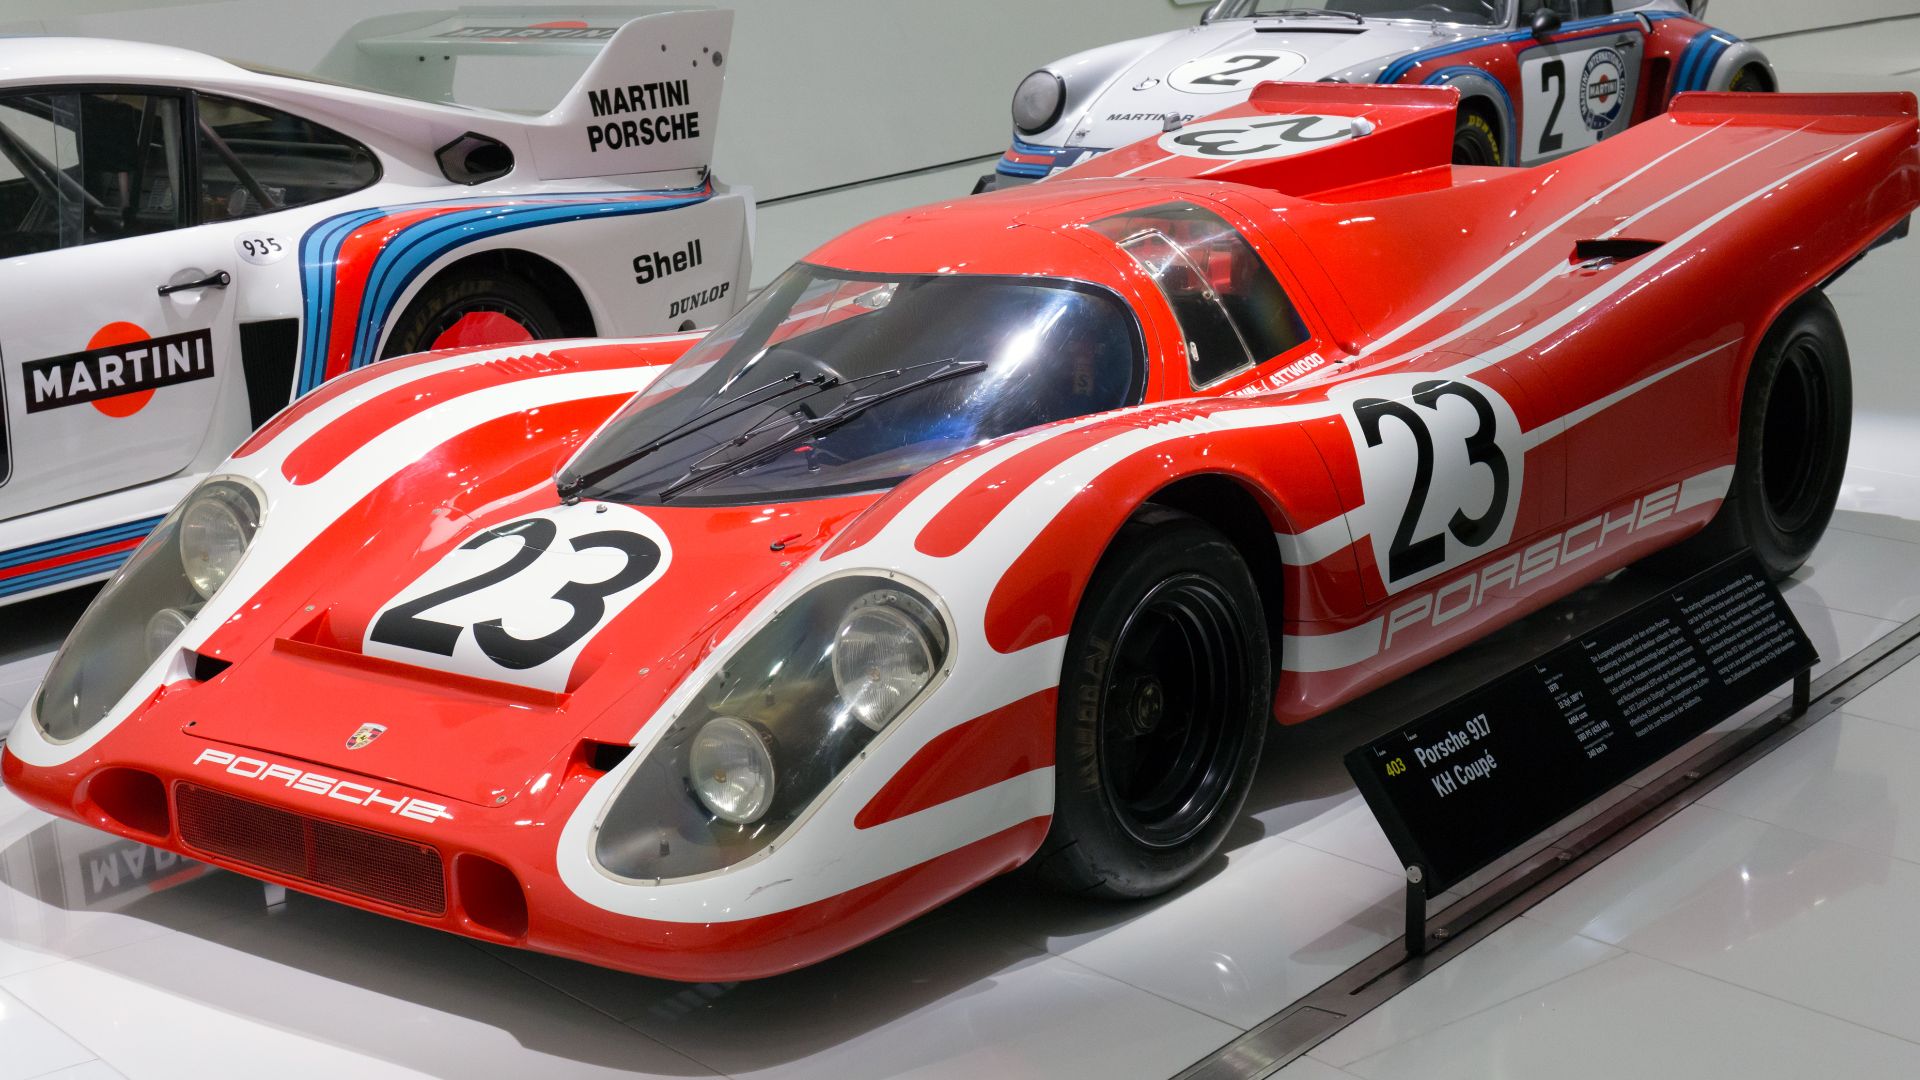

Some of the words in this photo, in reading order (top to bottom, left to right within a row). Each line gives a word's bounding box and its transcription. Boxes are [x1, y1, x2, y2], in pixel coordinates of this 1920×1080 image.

[1190, 54, 1280, 86] 2
[1589, 79, 1617, 98] MARTINI
[588, 79, 690, 117] MARTINI
[1106, 113, 1166, 121] MARTIN
[1538, 60, 1566, 154] 2
[587, 112, 700, 152] PORSCHE
[1173, 115, 1353, 156] 23
[243, 237, 282, 257] 935
[632, 239, 703, 285] Shell
[669, 282, 729, 319] DUNLOP
[33, 338, 206, 403] MARTINI
[1269, 352, 1325, 387] ATTWOOD
[1352, 379, 1510, 584] 23
[1384, 482, 1681, 651] PORSCHE
[369, 517, 662, 670] 23
[1548, 682, 1559, 692] 1970
[1414, 731, 1470, 768] Porsche
[1465, 713, 1491, 740] 917
[193, 748, 448, 824] PORSCHE
[1386, 757, 1406, 777] 403
[1431, 770, 1458, 797] KH
[1453, 748, 1498, 785] Coupé
